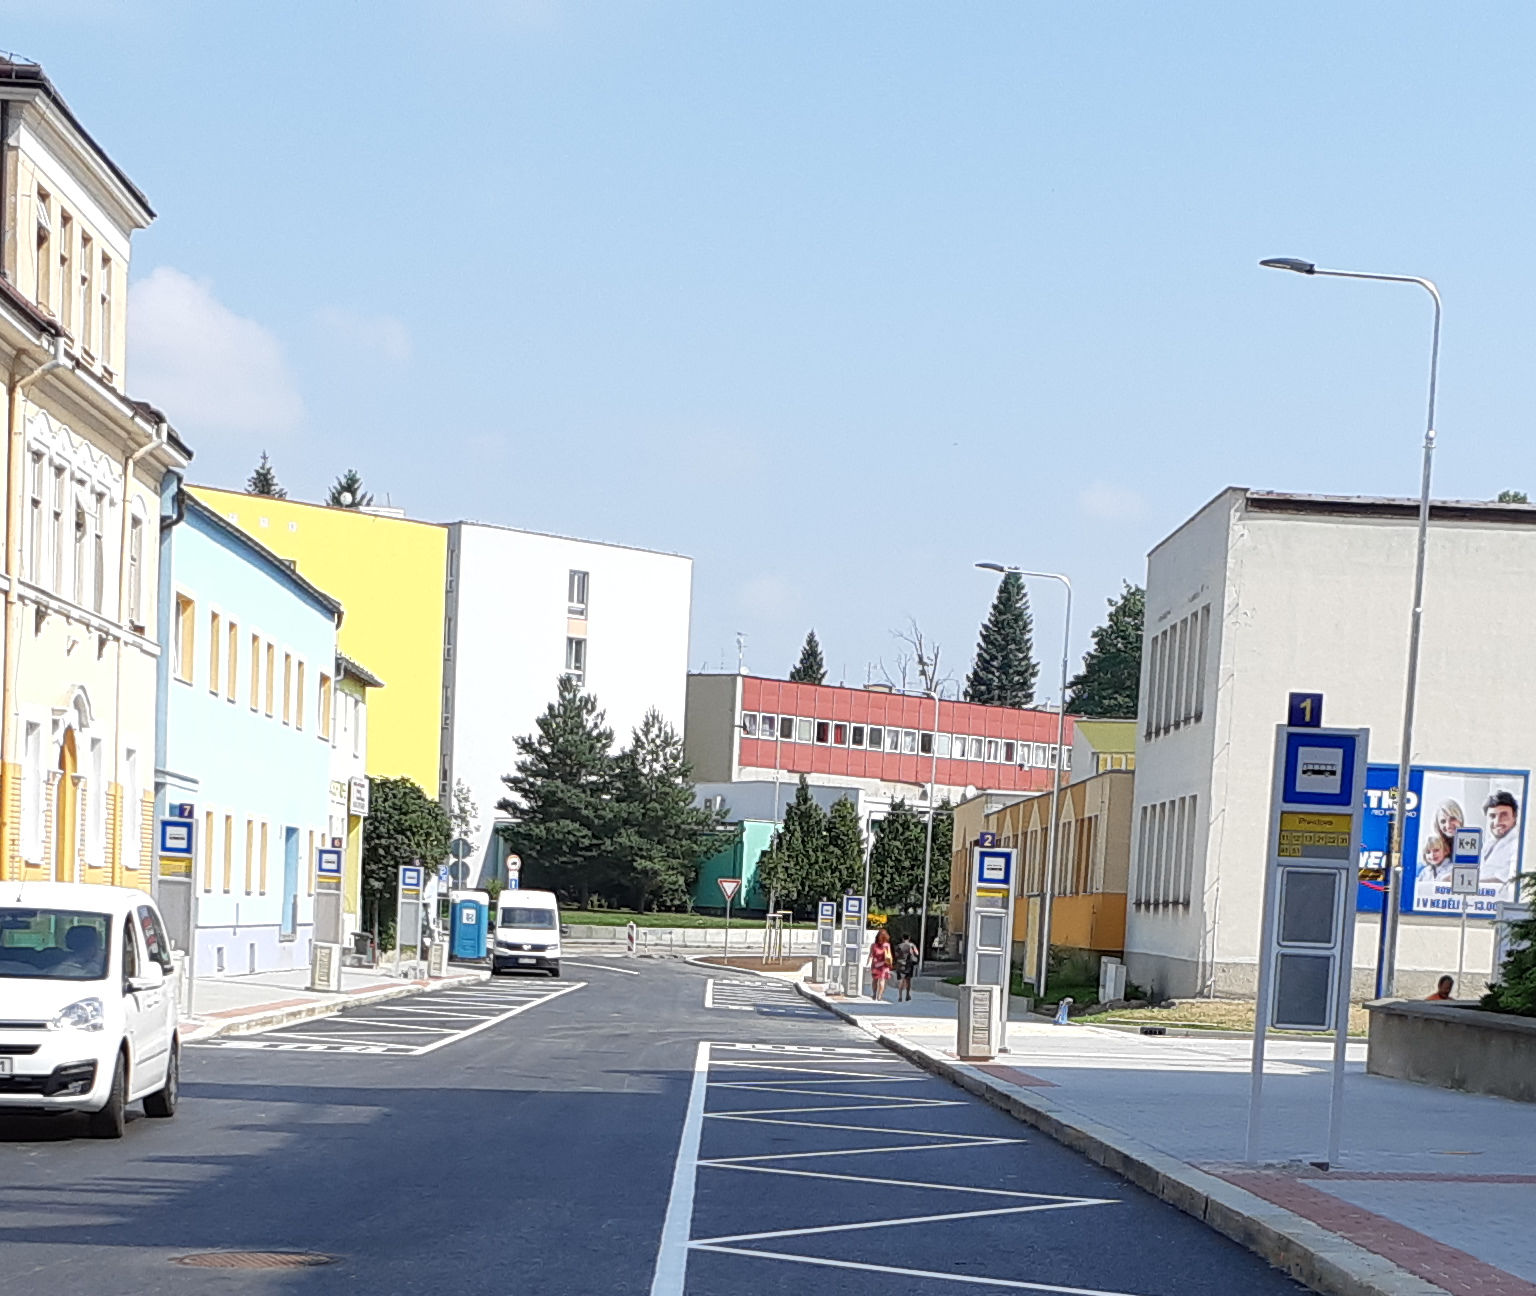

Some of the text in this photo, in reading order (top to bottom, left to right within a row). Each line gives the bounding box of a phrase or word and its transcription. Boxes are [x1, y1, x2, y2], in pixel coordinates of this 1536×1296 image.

[1300, 698, 1312, 722] 1
[183, 805, 191, 816] 7
[334, 838, 341, 847] 6
[983, 834, 992, 847] 2
[1458, 838, 1477, 850] K+R
